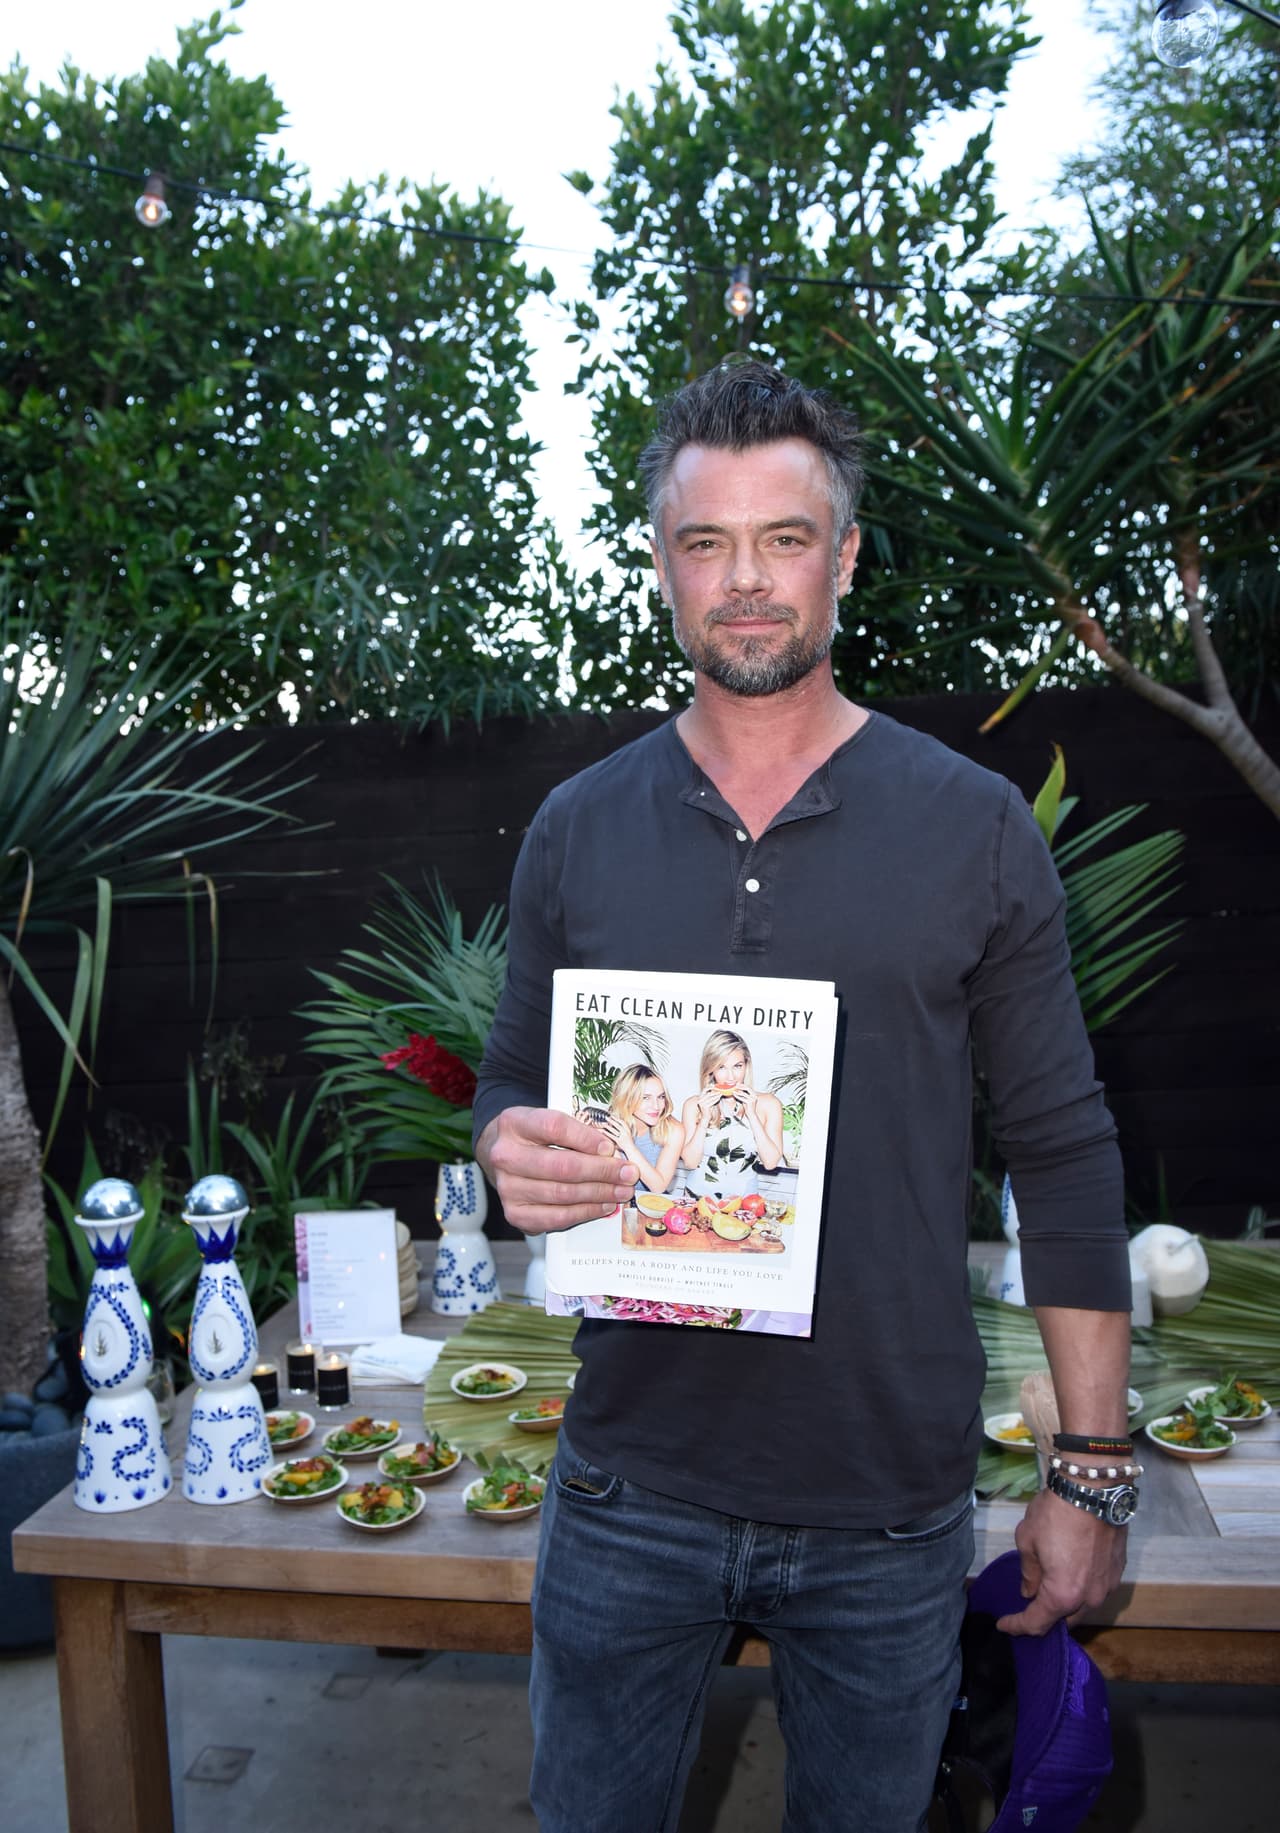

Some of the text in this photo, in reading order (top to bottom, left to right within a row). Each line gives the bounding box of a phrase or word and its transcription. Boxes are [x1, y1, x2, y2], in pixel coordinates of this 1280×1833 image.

[576, 992, 813, 1029] EAT CLEAN PLAY DIRTY
[617, 1259, 636, 1267] FOR
[651, 1262, 678, 1271] BODY
[680, 1265, 702, 1273] AND
[706, 1267, 729, 1275] LIFE
[733, 1269, 753, 1277] YOU
[756, 1271, 783, 1281] LOVE
